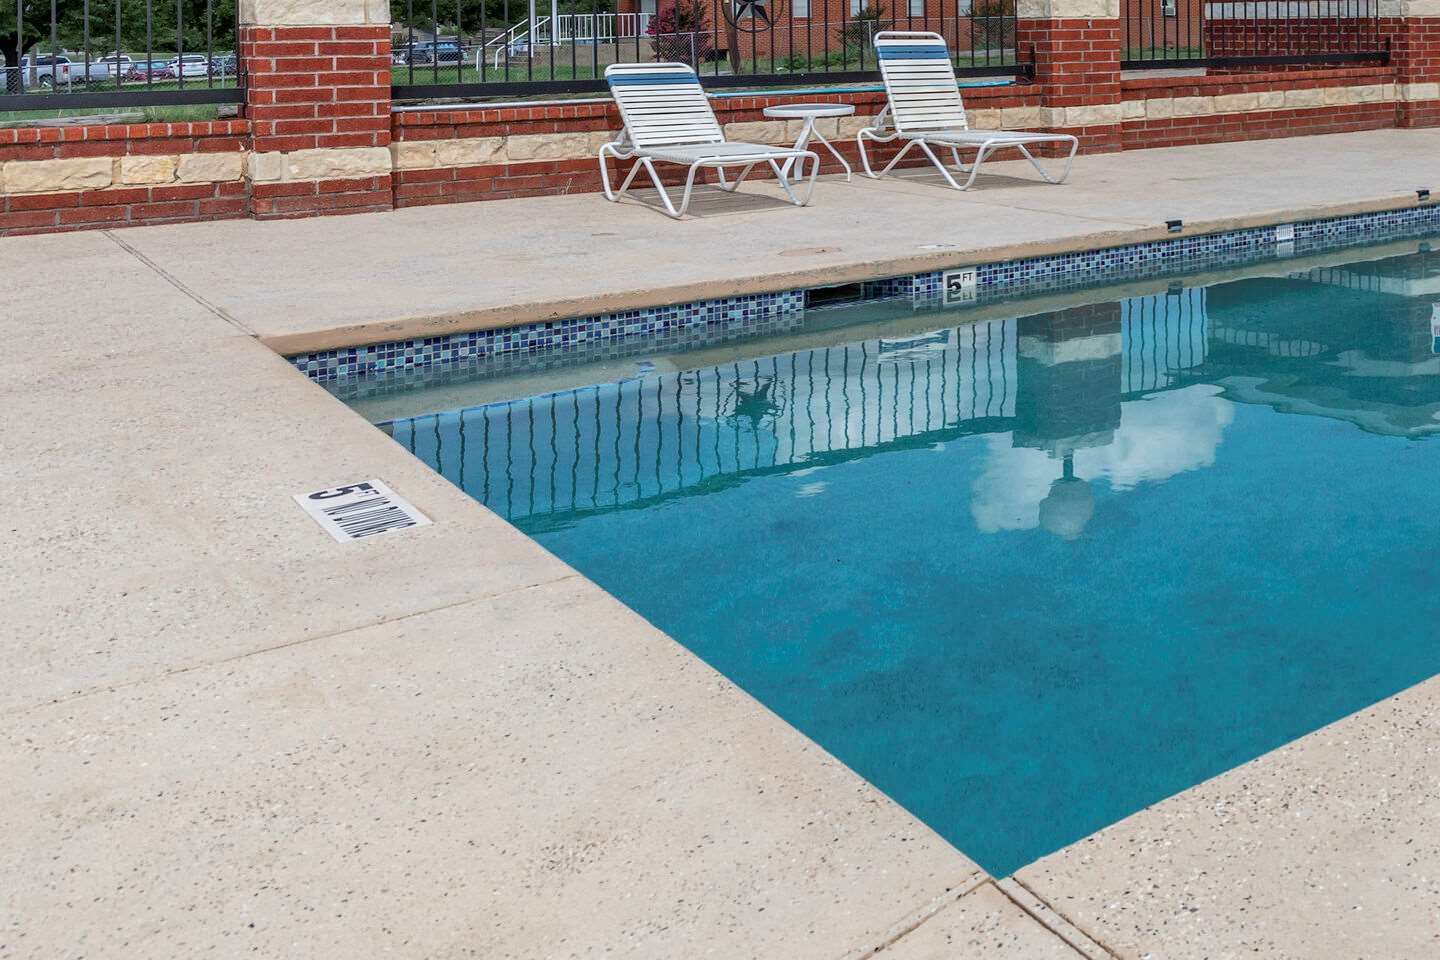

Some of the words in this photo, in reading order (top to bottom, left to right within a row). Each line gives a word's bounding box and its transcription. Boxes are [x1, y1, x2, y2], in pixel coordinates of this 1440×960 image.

[946, 274, 961, 290] 5
[963, 273, 973, 281] FT
[308, 482, 374, 500] 5
[322, 496, 391, 516] NO
